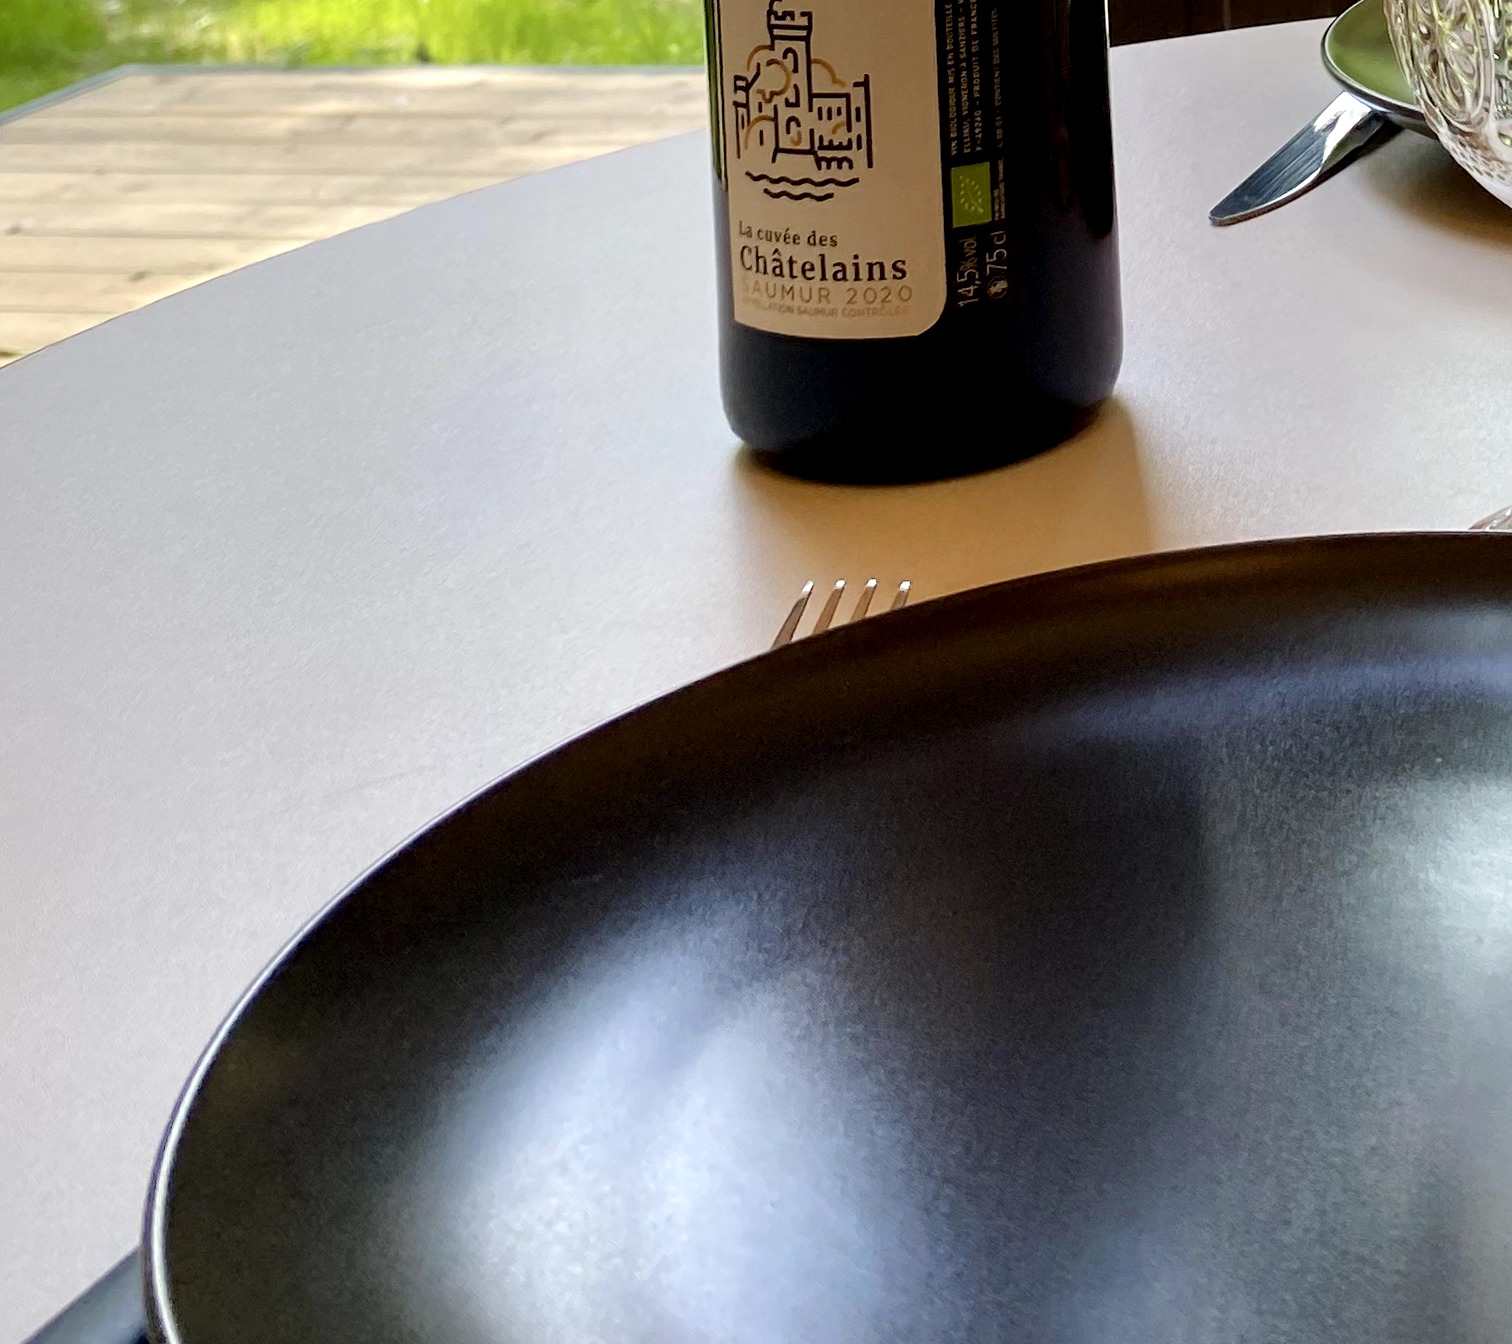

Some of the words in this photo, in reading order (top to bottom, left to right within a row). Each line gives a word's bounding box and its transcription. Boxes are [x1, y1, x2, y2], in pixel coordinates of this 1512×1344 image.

[944, 3, 953, 50] BOUTEILLE
[971, 39, 979, 52] DE
[972, 56, 980, 98] PRODUIT
[738, 220, 752, 239] La
[757, 227, 801, 245] cuvée
[807, 230, 838, 248] des
[990, 230, 1007, 245] cl
[740, 245, 907, 282] Châtelains
[986, 249, 1007, 275] 75
[742, 274, 831, 304] SAUMUR
[846, 285, 913, 305] 2020
